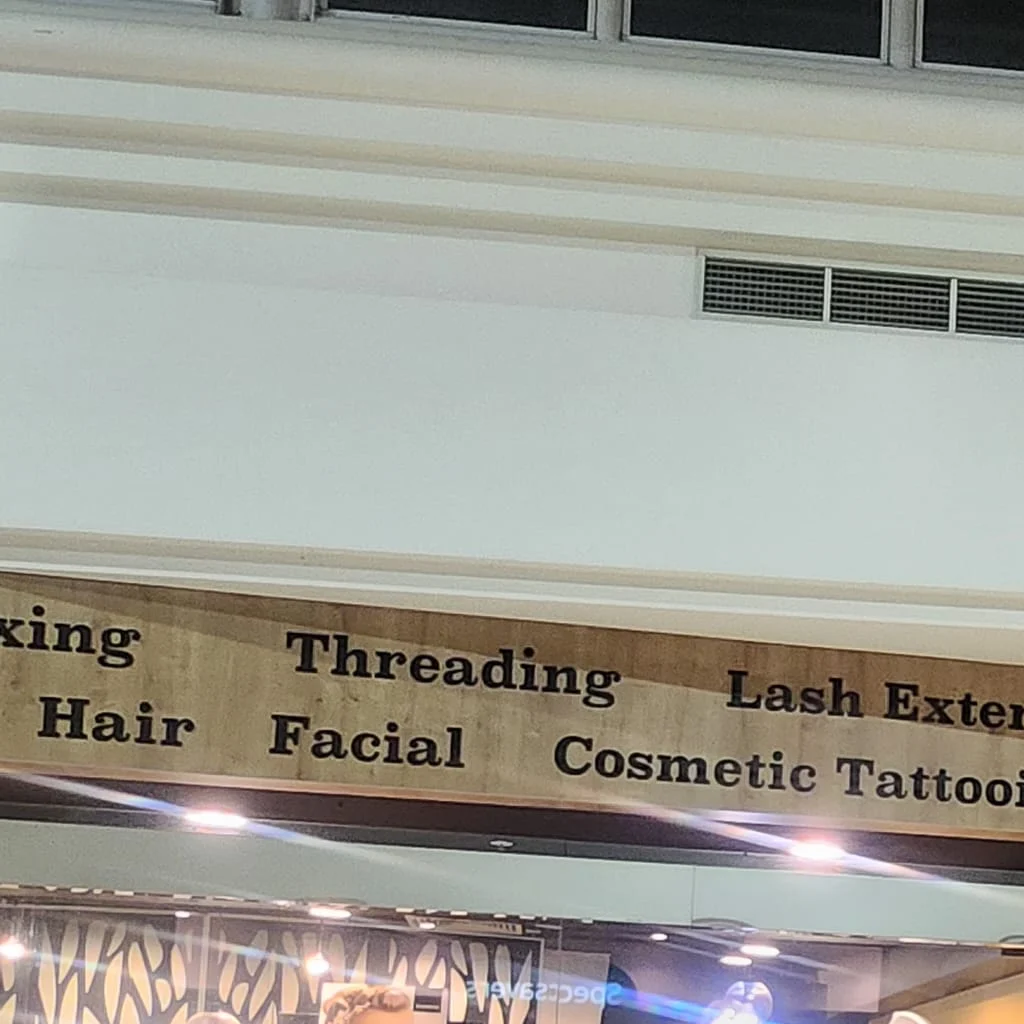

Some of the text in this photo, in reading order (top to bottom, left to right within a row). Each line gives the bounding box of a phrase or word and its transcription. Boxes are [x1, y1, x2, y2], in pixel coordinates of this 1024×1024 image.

[0, 605, 141, 669] xing
[286, 631, 622, 709] Threading
[726, 670, 864, 719] Lash
[37, 697, 196, 747] Hair
[269, 714, 465, 769] Facial
[554, 735, 818, 793] Cosmetic
